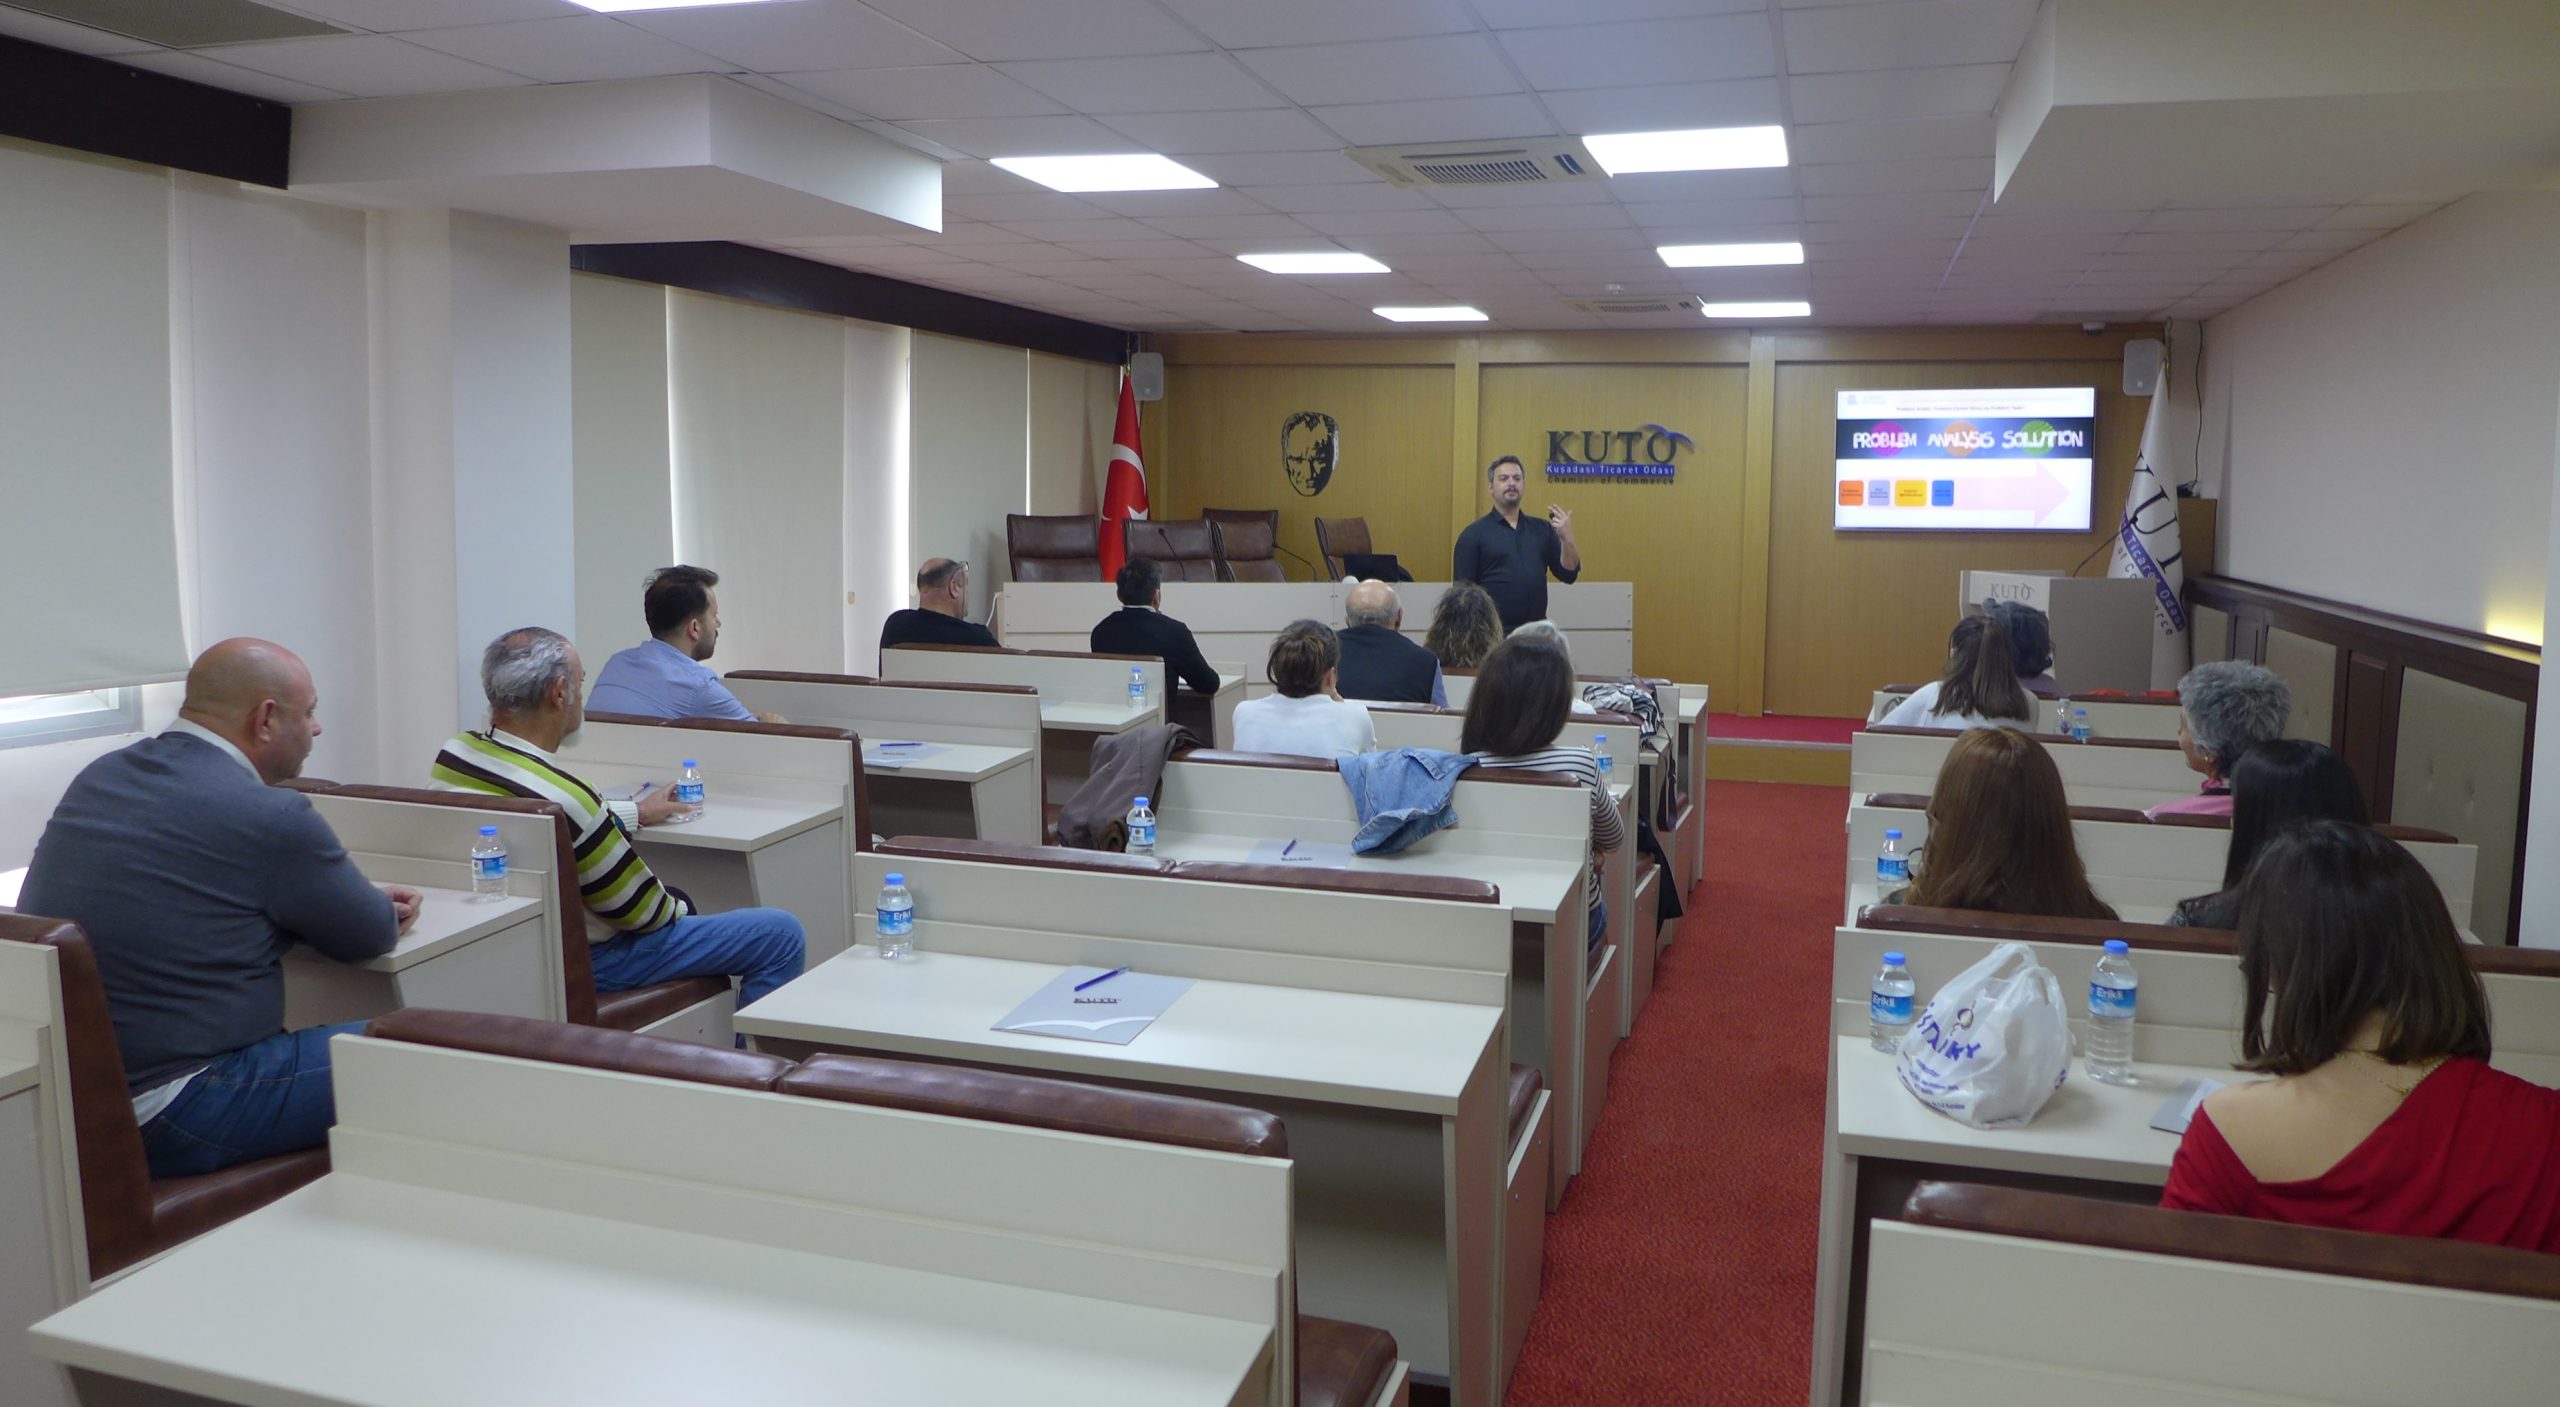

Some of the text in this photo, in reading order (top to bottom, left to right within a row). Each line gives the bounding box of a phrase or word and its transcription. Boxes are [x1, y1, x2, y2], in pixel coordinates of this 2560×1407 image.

[1853, 430, 2084, 449] PROBLEM ANALYSIS SOLUTION
[1546, 431, 1677, 464] KUTO
[1599, 465, 1639, 474] Ticaret
[1616, 476, 1675, 485] Commerce
